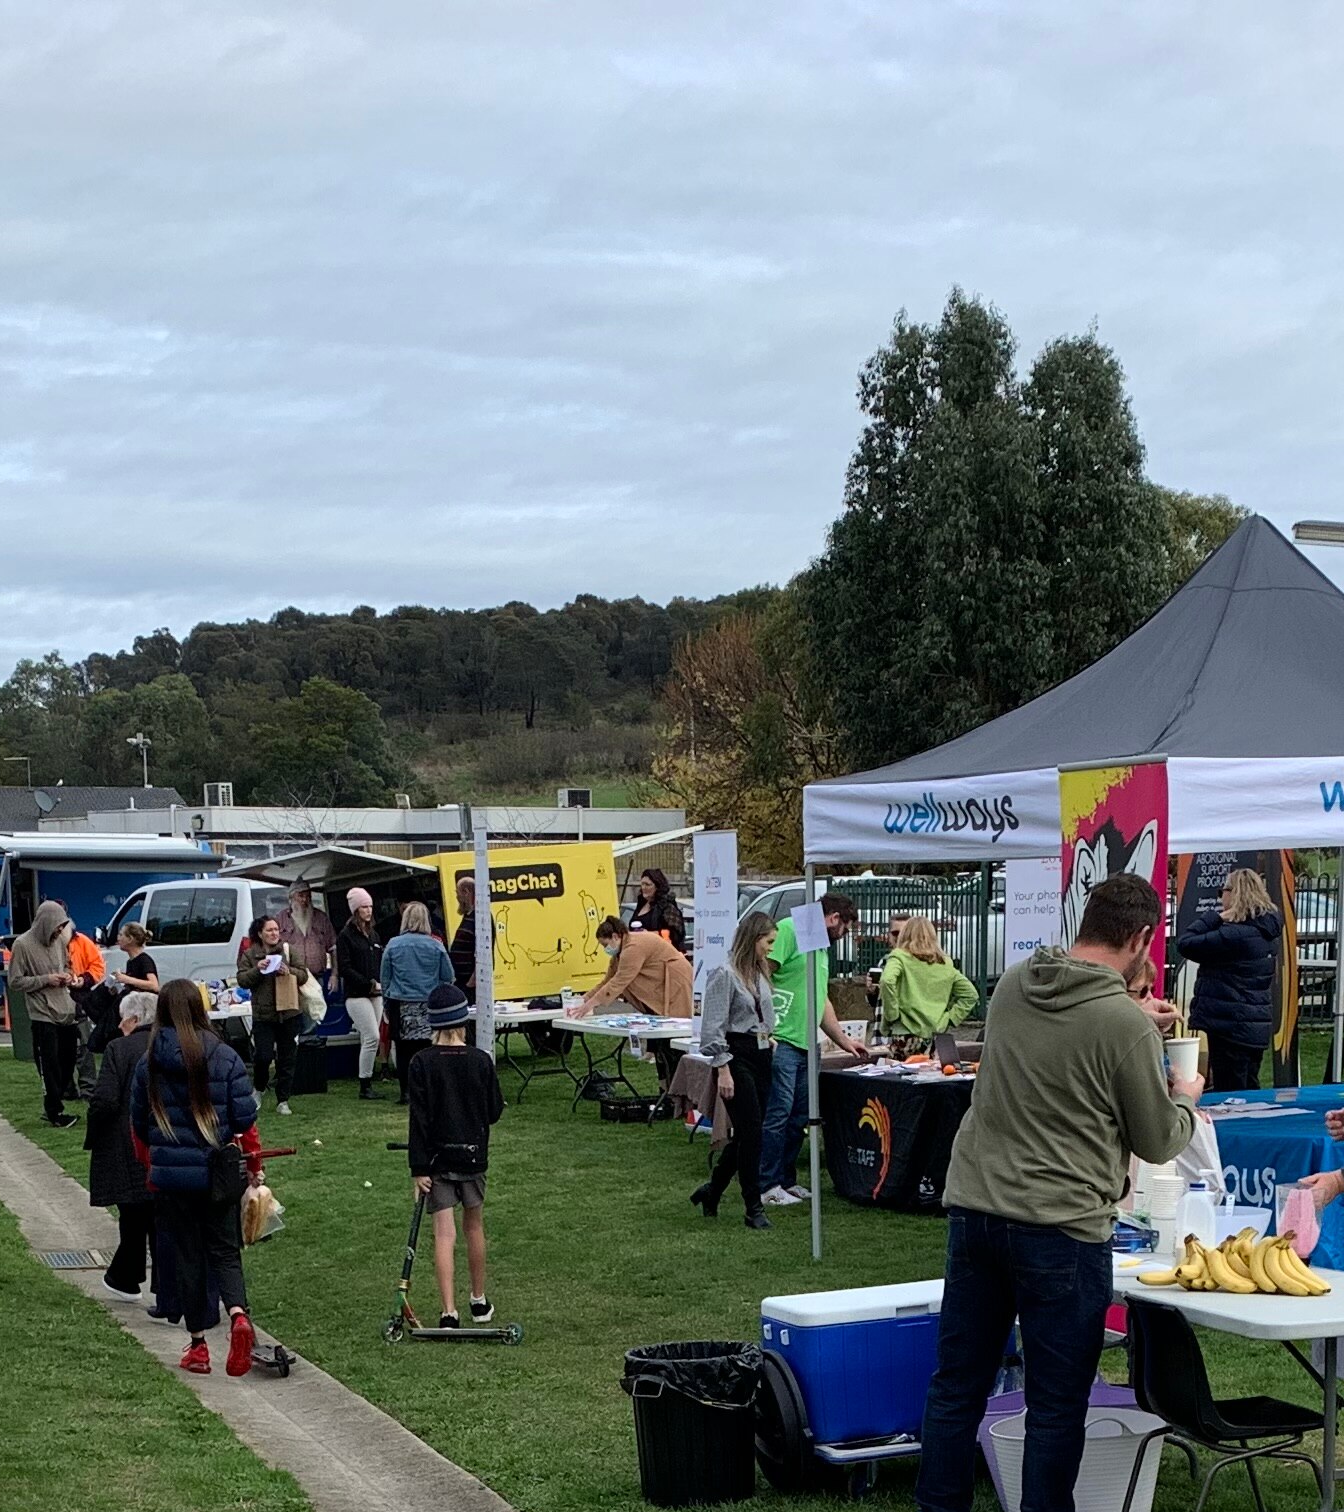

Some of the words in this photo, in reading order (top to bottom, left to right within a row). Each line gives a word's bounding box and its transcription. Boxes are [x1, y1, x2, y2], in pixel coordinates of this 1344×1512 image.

[883, 792, 1019, 843] wellways
[1196, 851, 1238, 864] ABORIGINAL
[1201, 863, 1232, 876] SUPPORT
[1197, 875, 1227, 888] PROGRA
[1014, 891, 1035, 901] Your
[1013, 906, 1032, 915] can
[1033, 903, 1056, 916] help
[1013, 937, 1042, 950] read
